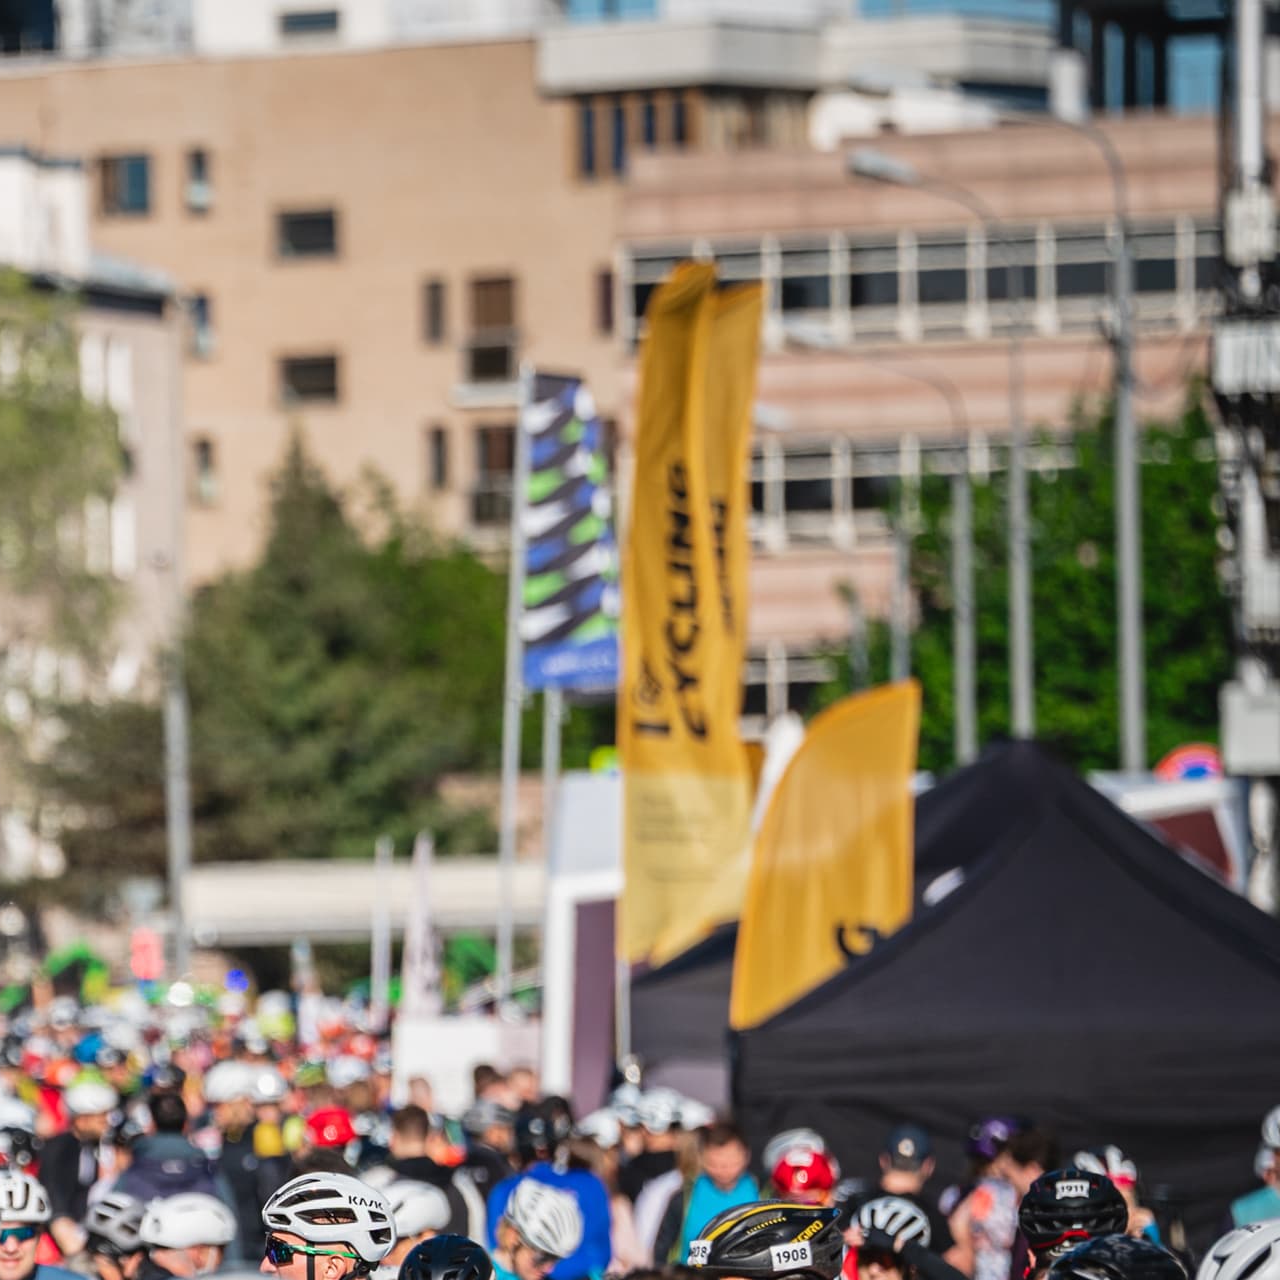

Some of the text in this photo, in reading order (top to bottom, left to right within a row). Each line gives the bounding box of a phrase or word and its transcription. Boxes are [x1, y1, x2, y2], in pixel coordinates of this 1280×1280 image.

[1061, 1184, 1085, 1194] 1911
[348, 1195, 384, 1211] KASK
[776, 1247, 808, 1265] 1908
